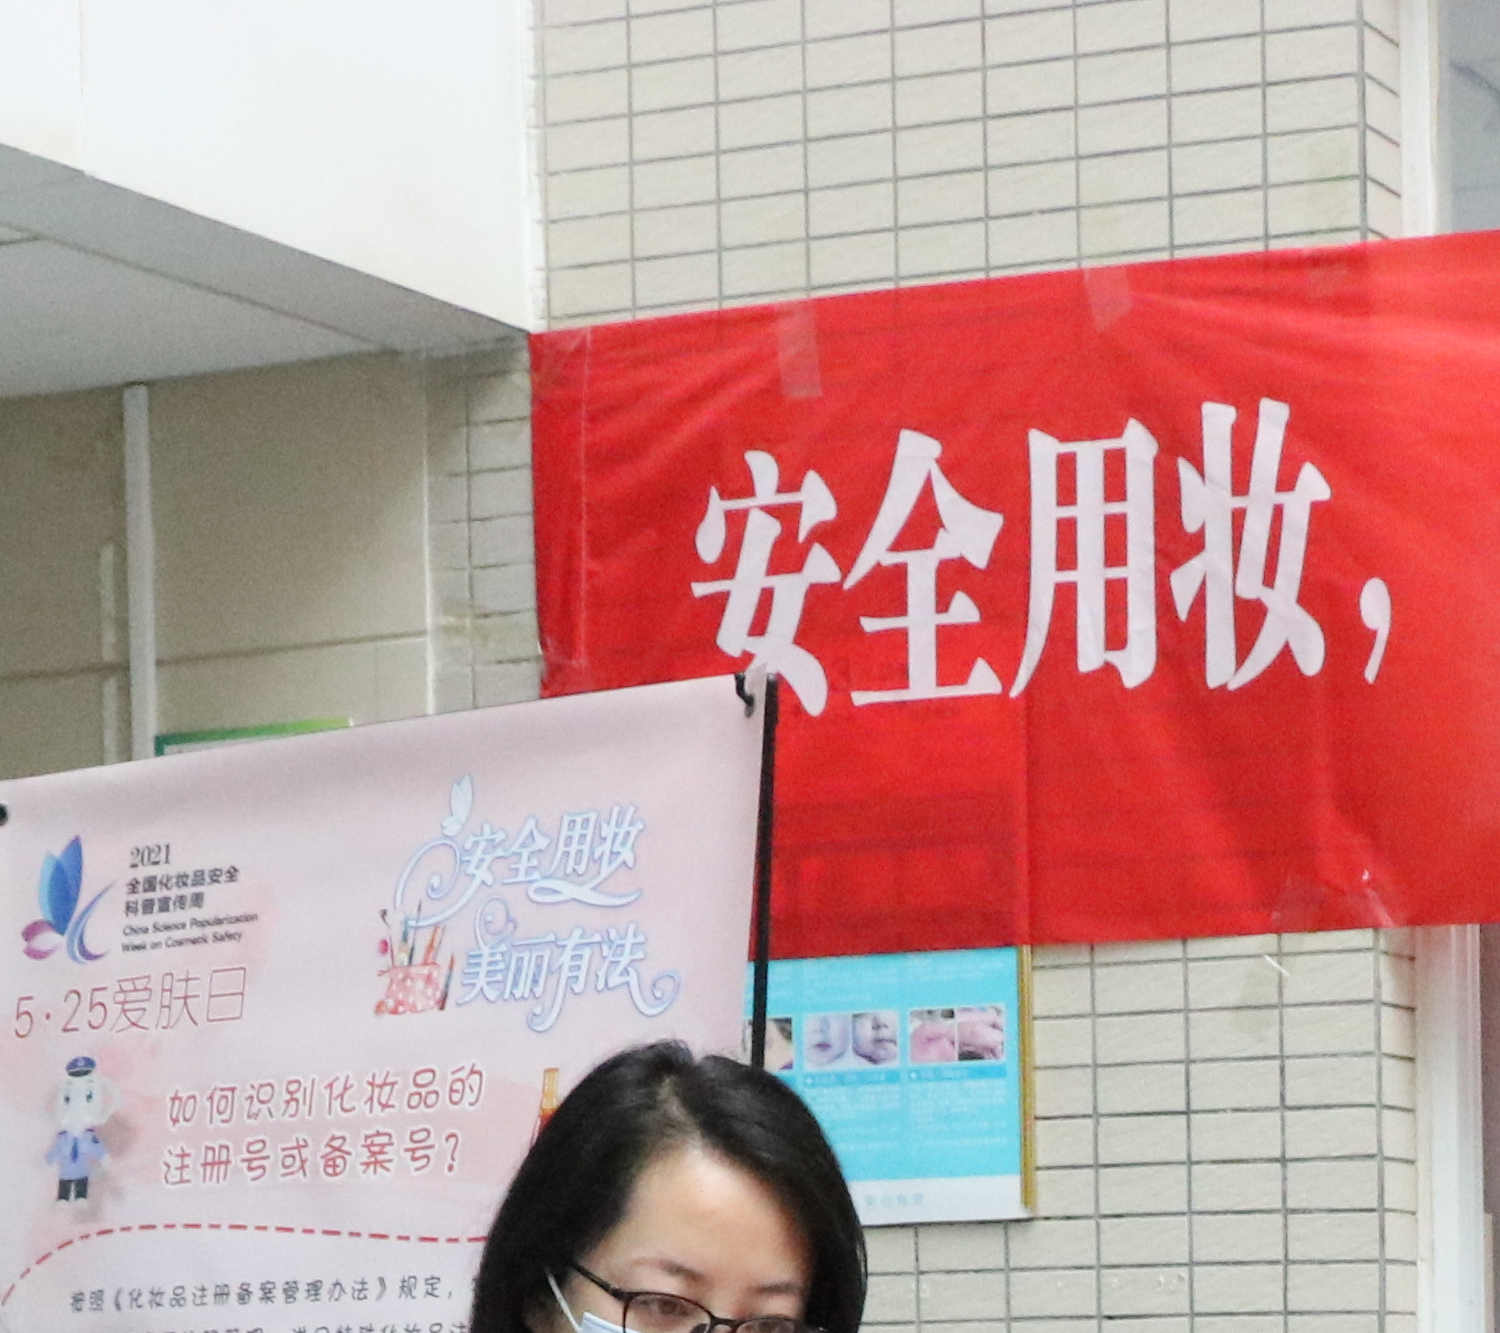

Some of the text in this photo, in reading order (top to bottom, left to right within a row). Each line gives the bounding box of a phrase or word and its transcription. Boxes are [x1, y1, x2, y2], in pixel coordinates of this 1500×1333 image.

[126, 865, 239, 895] 全国化妆品安全
[129, 843, 171, 868] 2021
[455, 803, 648, 909] 安全用妆
[456, 922, 682, 1032] 美丽有法
[168, 1061, 485, 1127] 如何识别化妆品的
